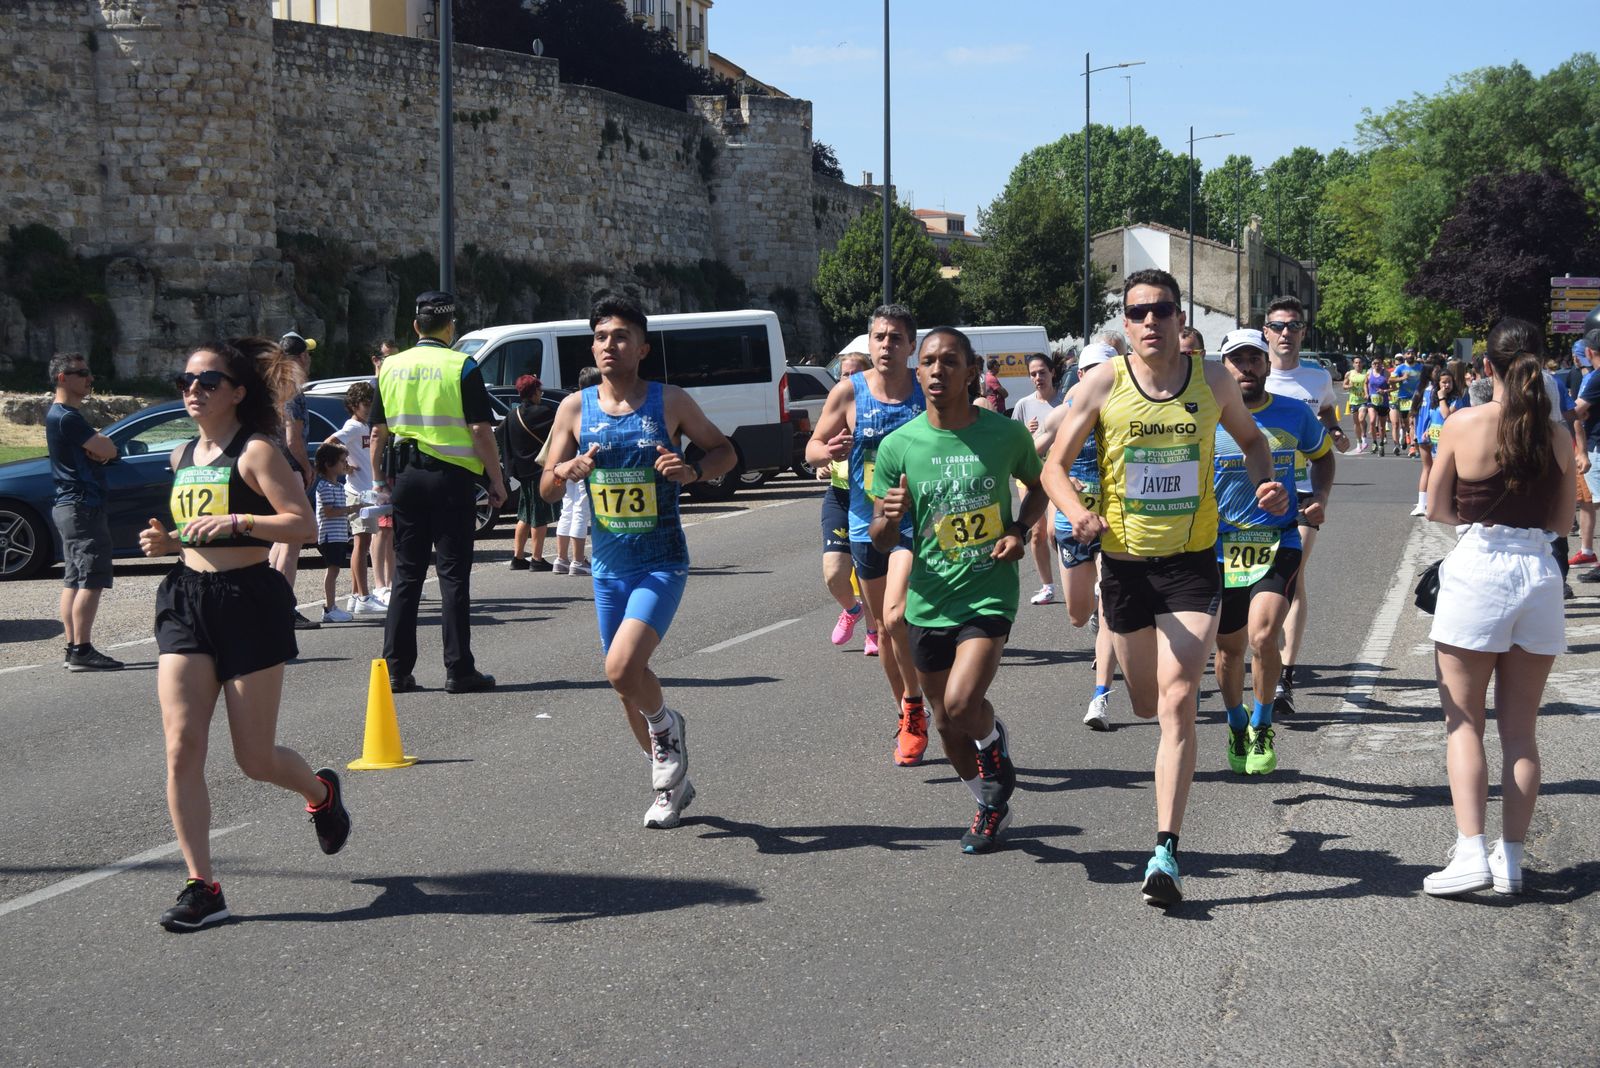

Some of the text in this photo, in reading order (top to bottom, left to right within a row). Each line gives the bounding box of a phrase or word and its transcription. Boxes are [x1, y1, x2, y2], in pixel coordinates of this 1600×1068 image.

[1130, 421, 1197, 437] RUN & GO
[1166, 455, 1191, 463] RURAL
[1141, 475, 1182, 495] JAVIER
[177, 488, 213, 518] 112
[598, 487, 646, 514] 173
[1145, 501, 1196, 511] CAJA RURAL
[610, 520, 654, 529] CAJA RURAL
[950, 513, 989, 543] 32
[1229, 545, 1271, 568] 208
